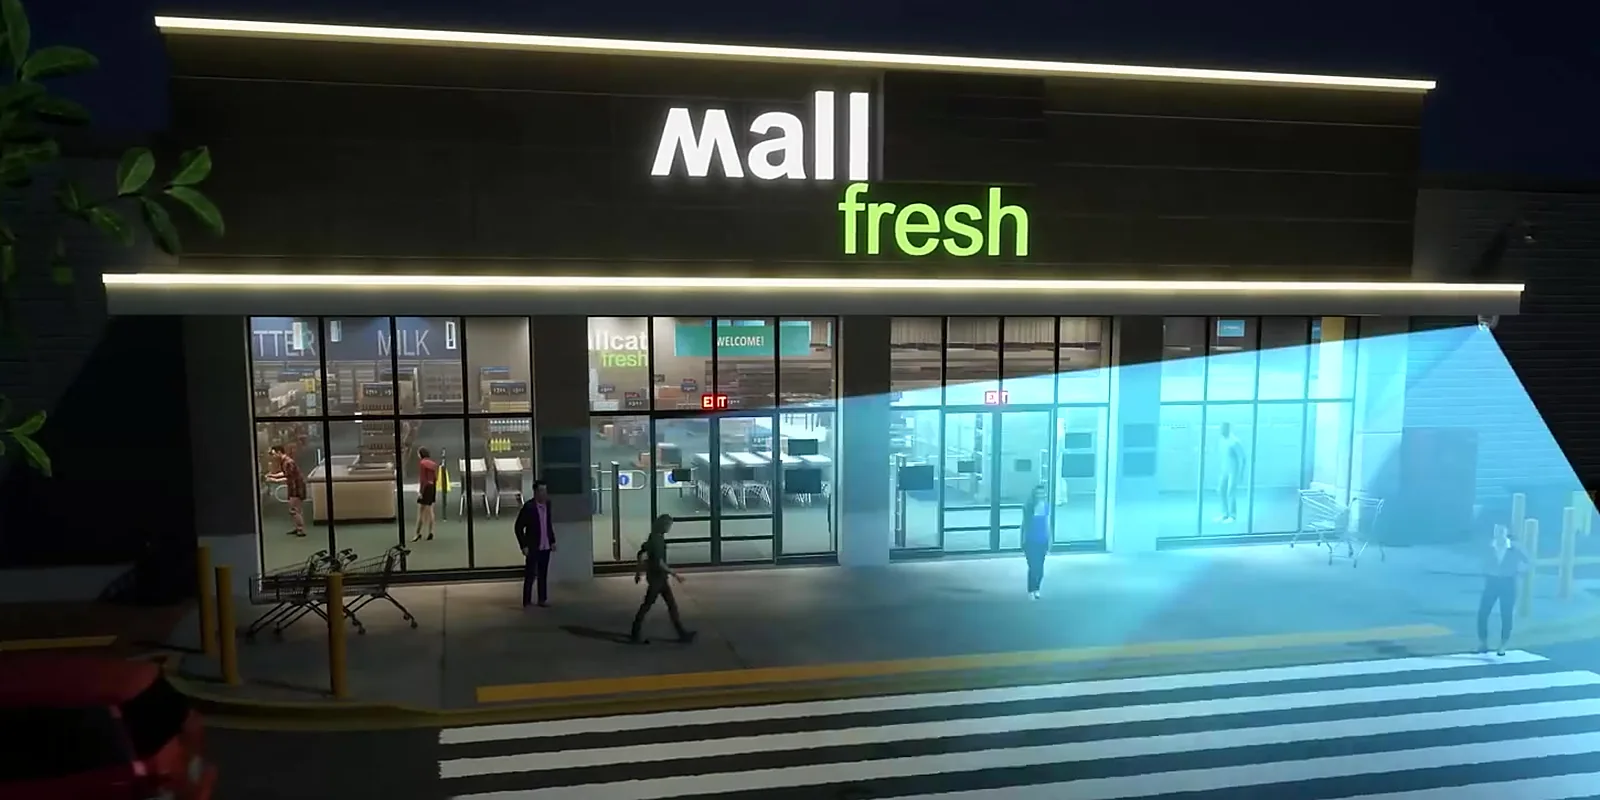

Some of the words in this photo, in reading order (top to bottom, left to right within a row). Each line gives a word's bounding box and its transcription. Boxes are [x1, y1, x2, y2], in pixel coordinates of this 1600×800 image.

[651, 90, 869, 180] Mall
[838, 182, 1029, 257] fresh
[377, 330, 430, 356] MILK
